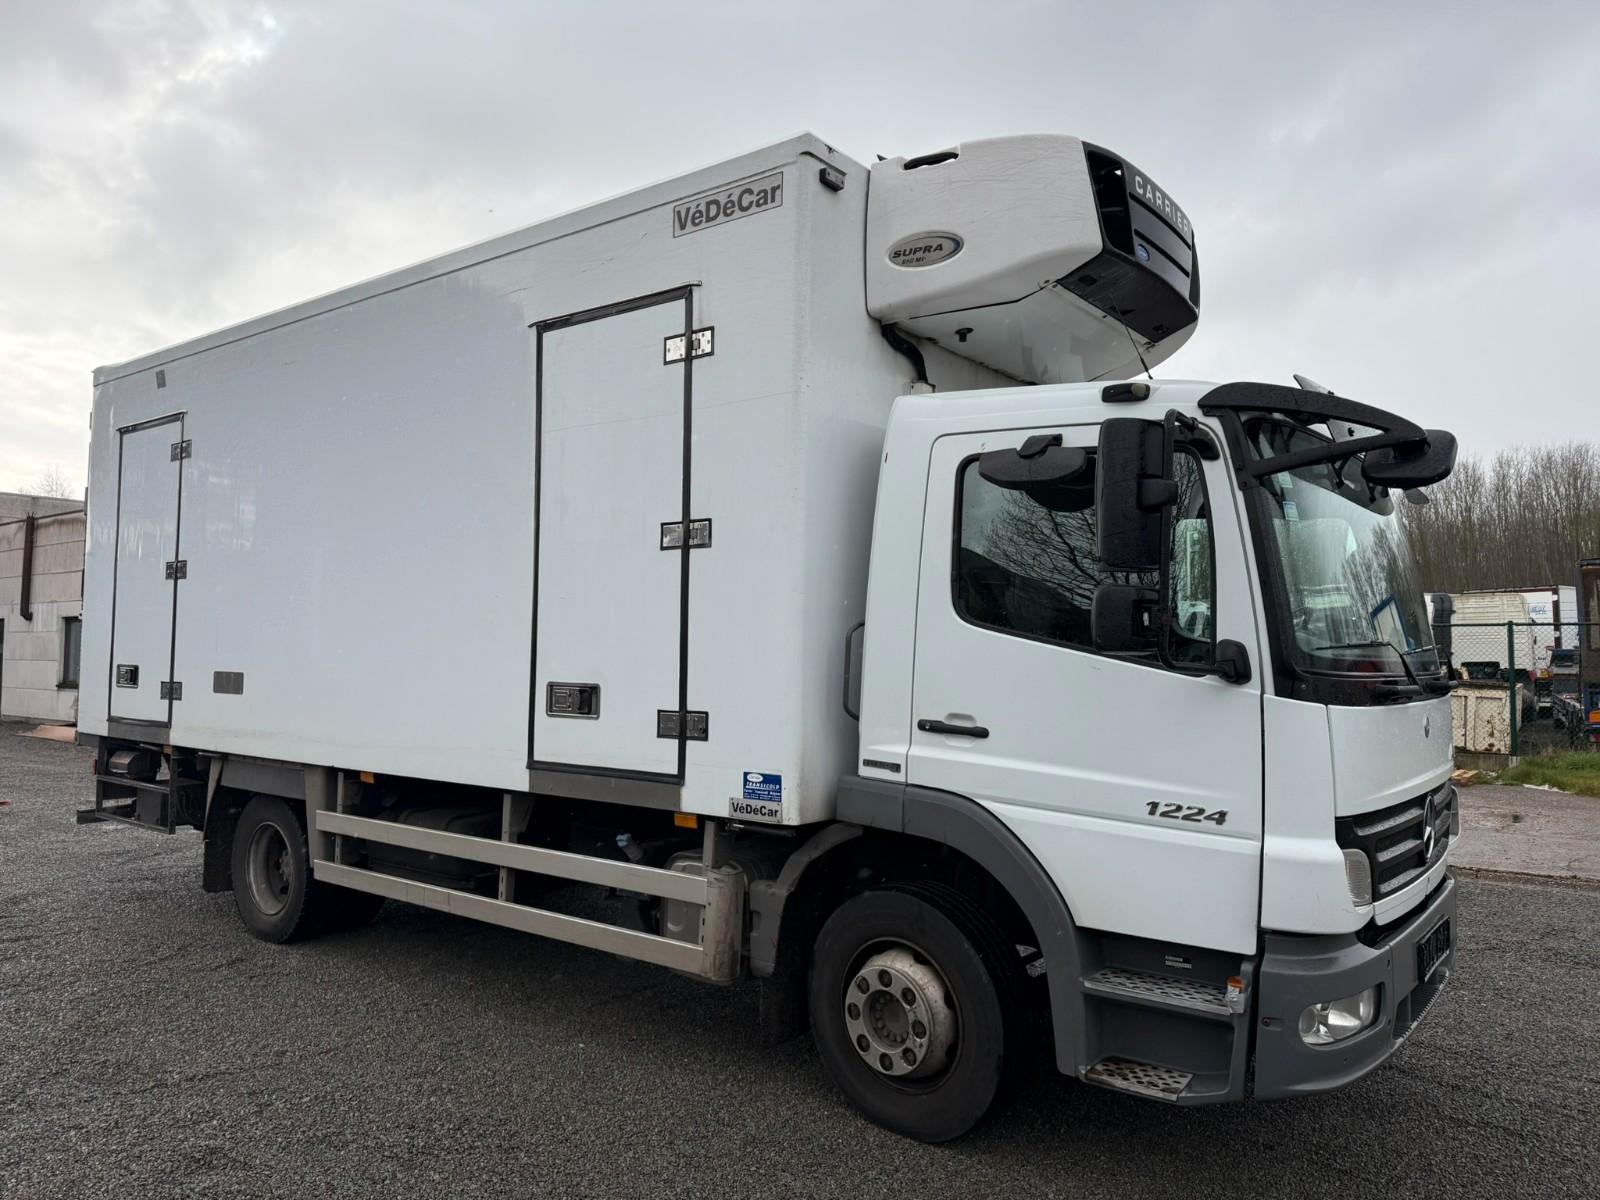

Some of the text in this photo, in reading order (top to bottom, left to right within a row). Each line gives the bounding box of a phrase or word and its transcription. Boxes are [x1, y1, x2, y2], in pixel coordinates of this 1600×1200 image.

[676, 184, 781, 231] VéDéCar
[1135, 175, 1189, 234] CARRIER
[892, 243, 943, 259] SUPRA
[1146, 801, 1228, 825] 1224
